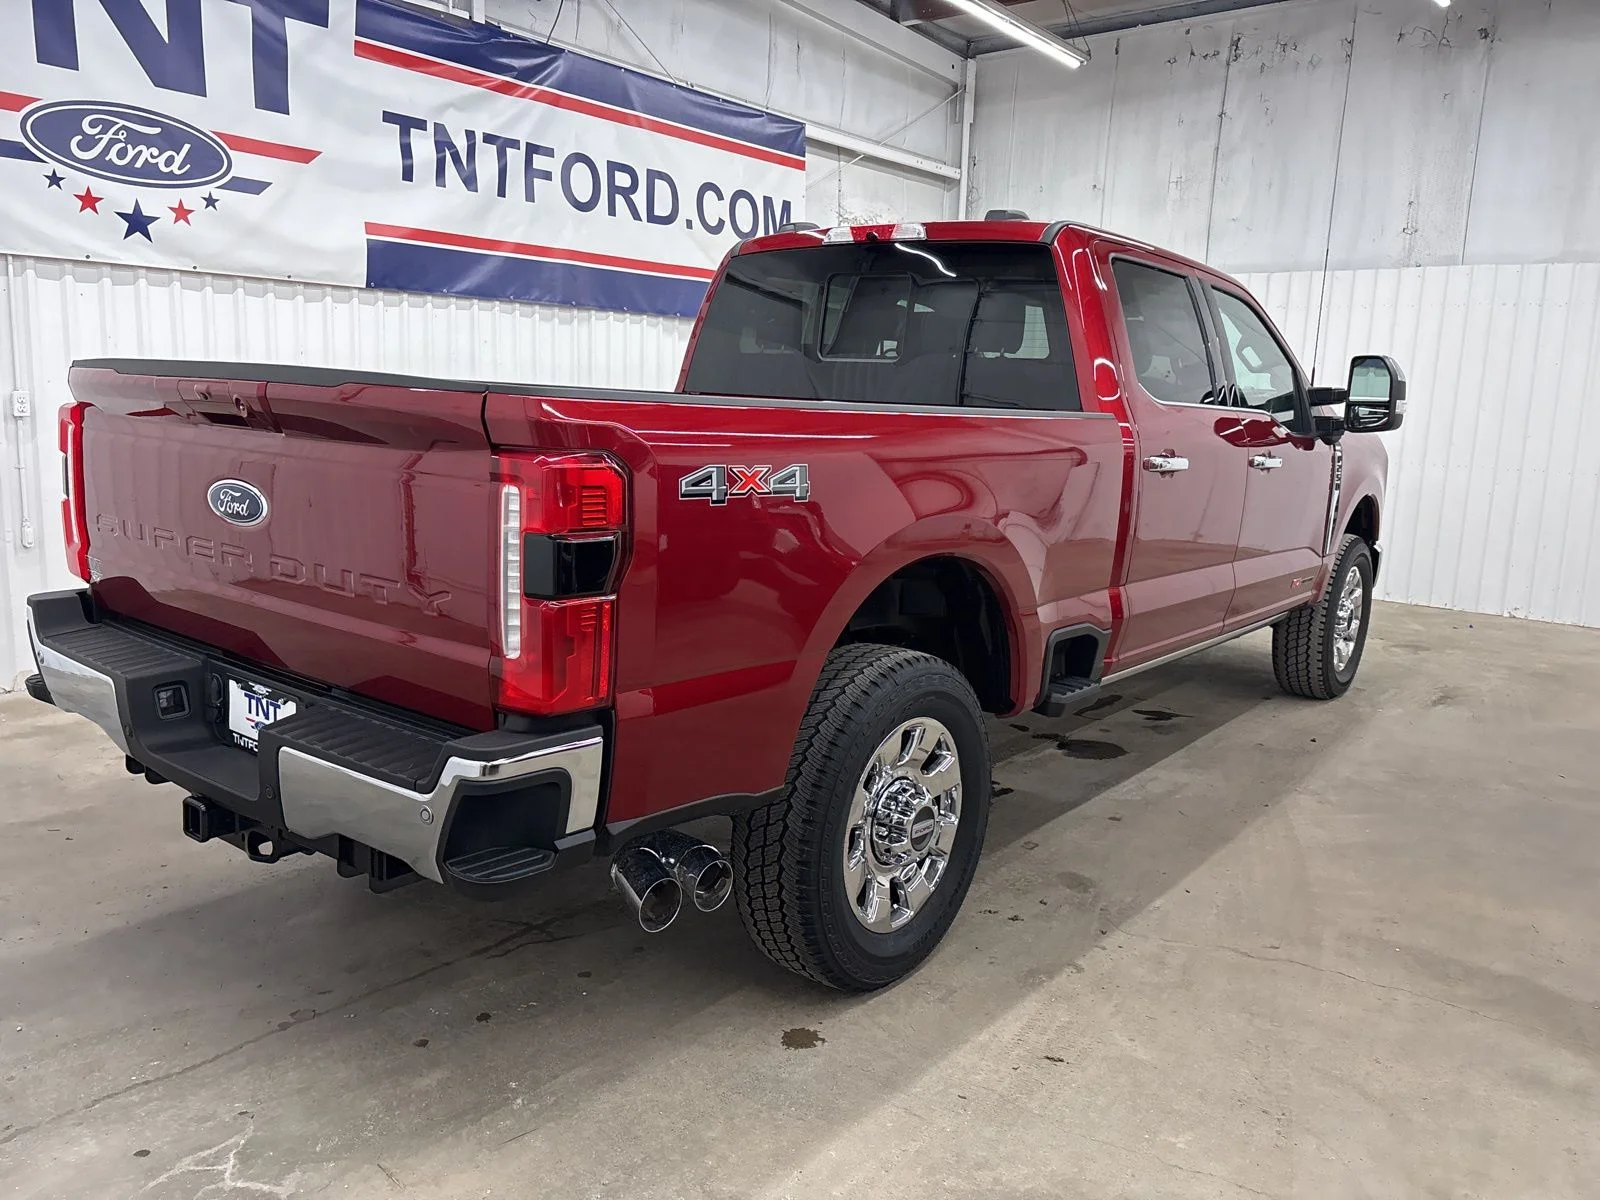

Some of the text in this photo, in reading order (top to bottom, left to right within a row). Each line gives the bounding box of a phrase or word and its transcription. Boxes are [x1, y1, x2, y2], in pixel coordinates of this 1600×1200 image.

[69, 113, 192, 175] Ford
[382, 110, 792, 240] TNTFORD.COM
[217, 488, 250, 517] Ford
[96, 513, 452, 616] SUPER DUTY
[243, 692, 281, 722] TNT
